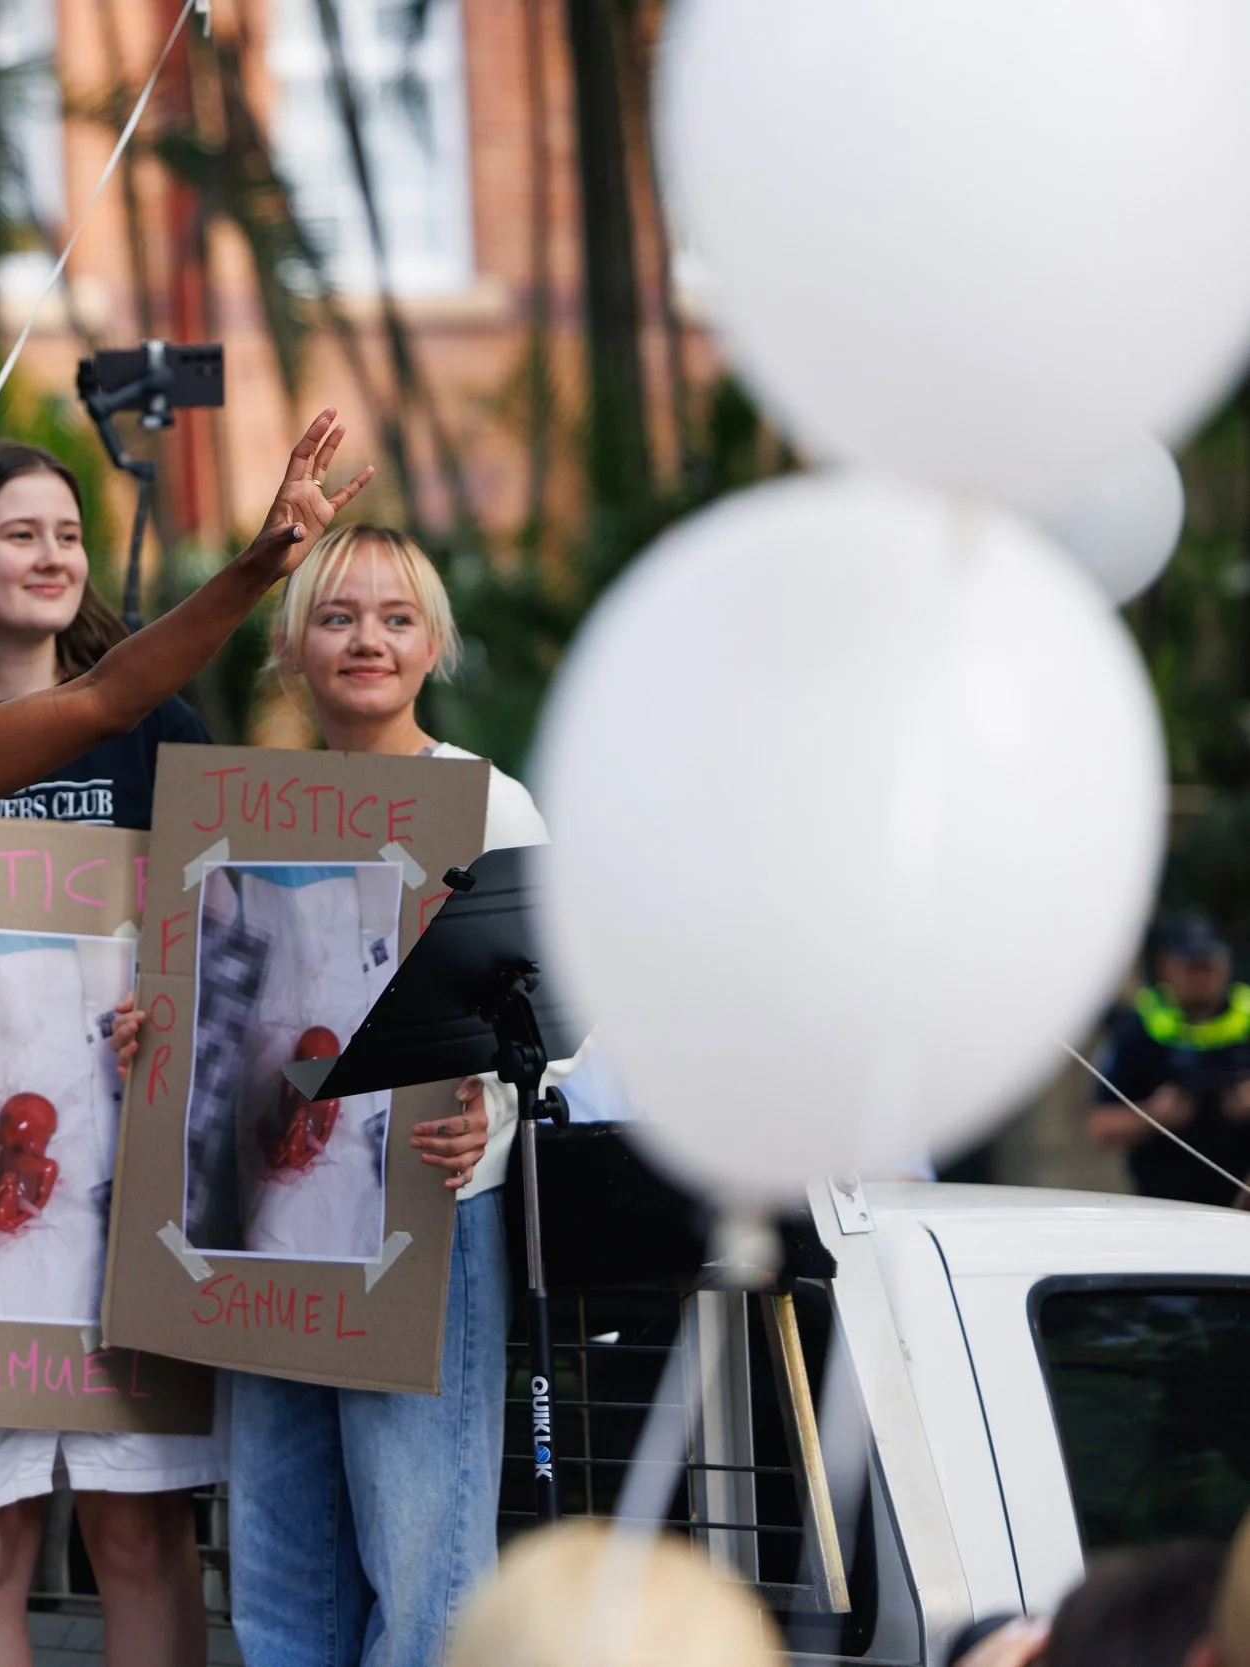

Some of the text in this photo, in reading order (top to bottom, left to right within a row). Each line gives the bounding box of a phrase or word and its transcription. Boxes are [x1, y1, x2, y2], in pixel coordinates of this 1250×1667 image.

[52, 788, 114, 819] CLUB
[192, 766, 417, 843] JUSTICE
[531, 1375, 553, 1479] QUIKLOK
